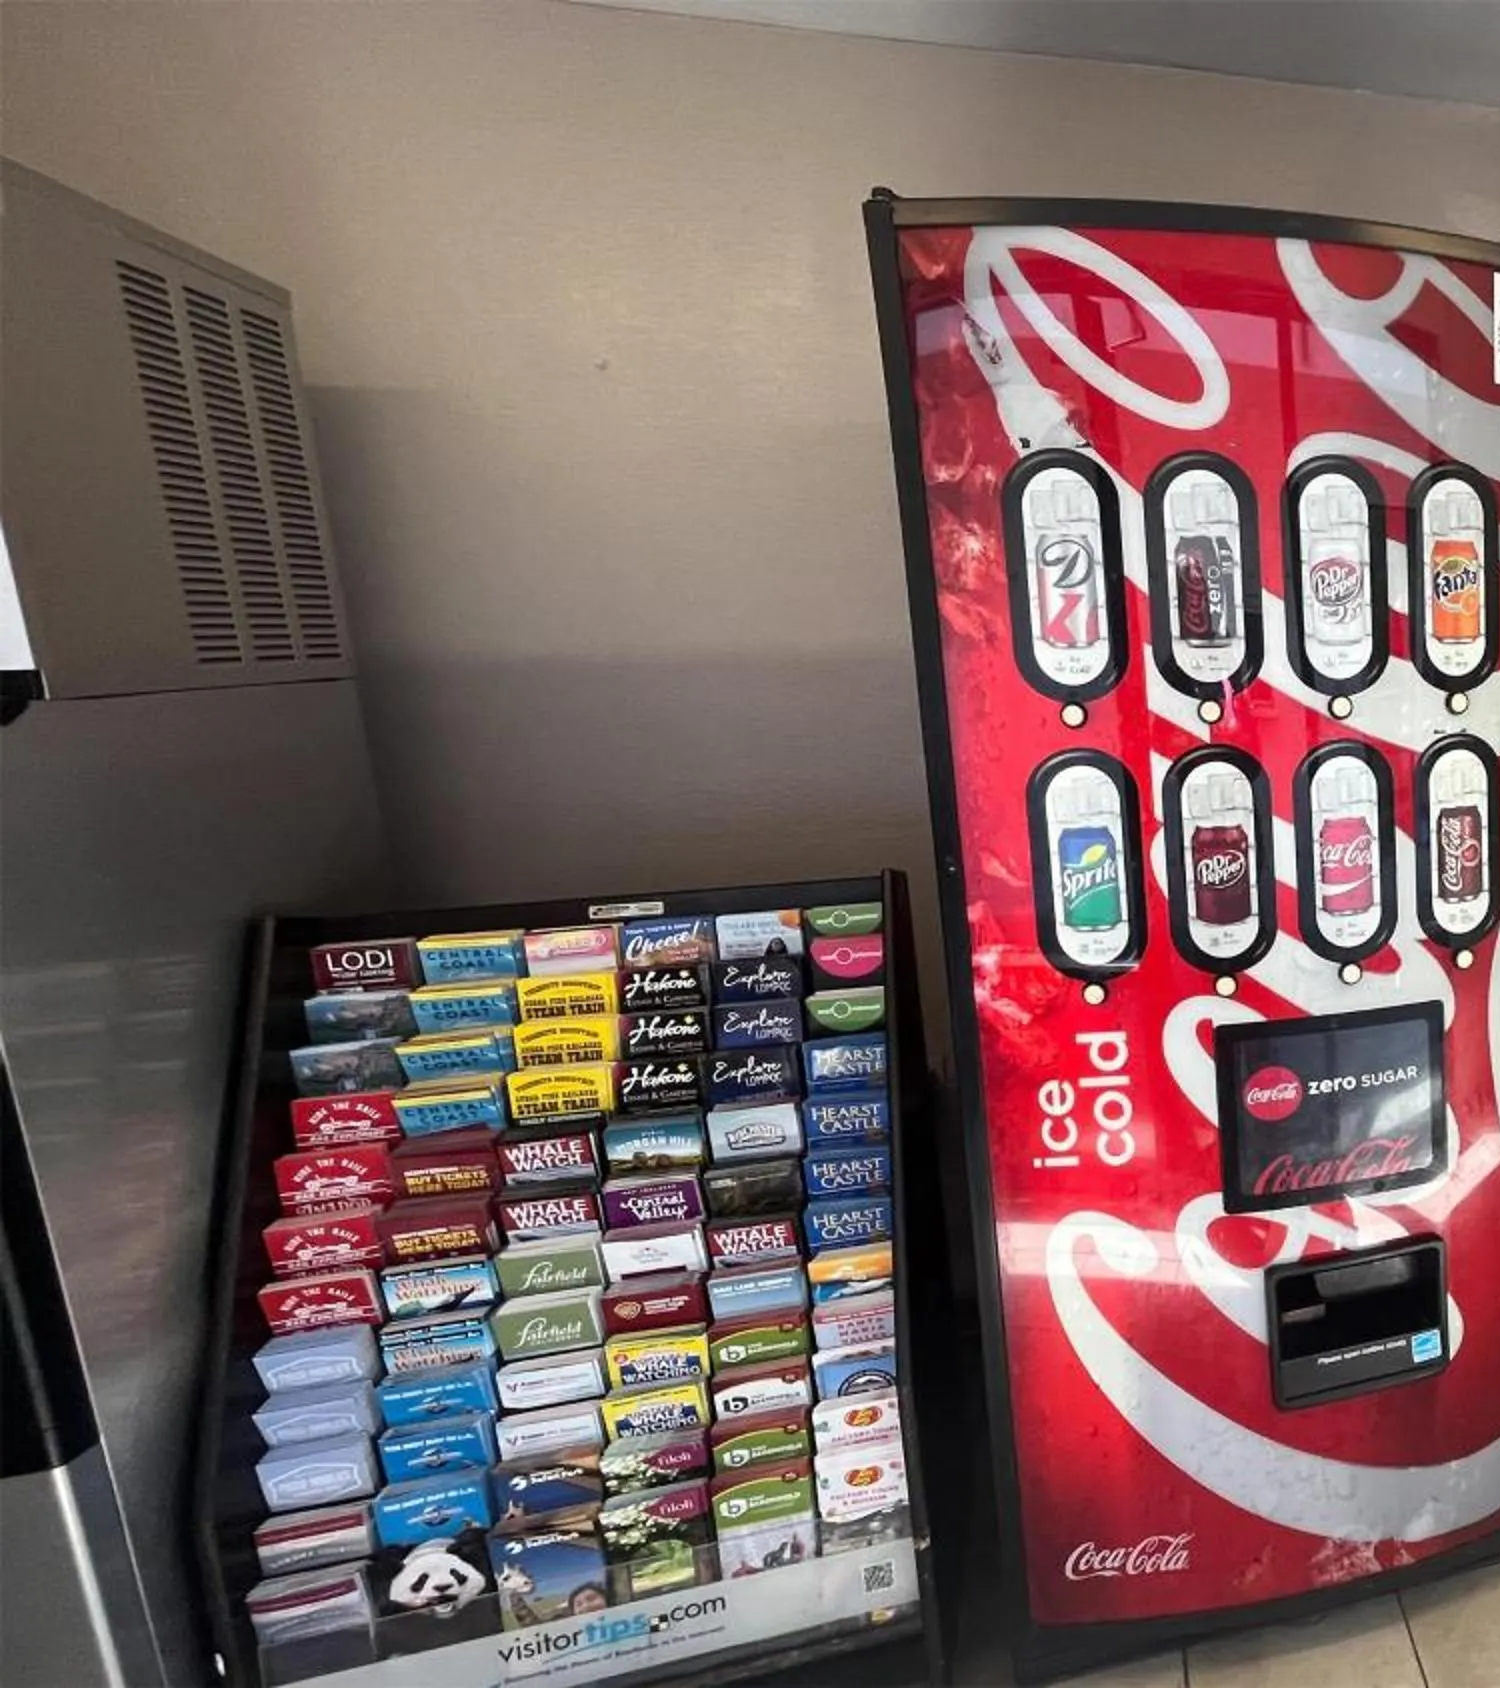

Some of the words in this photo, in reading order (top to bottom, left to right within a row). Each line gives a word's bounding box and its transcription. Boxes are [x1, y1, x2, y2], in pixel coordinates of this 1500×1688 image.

[1208, 566, 1221, 614] zero
[1315, 570, 1358, 600] Pepper
[1214, 853, 1232, 869] Dr
[1198, 857, 1245, 885] Pepper
[626, 920, 700, 961] Cheese!
[325, 948, 395, 973] LODI
[427, 949, 504, 963] CENTRAL
[440, 958, 496, 971] COAST
[624, 969, 697, 999] Hakone
[723, 962, 792, 990] Explore
[419, 998, 501, 1014] CENTRAL
[434, 1008, 492, 1020] COAST
[526, 1006, 566, 1018] STEAM
[570, 1002, 605, 1015] TRAIN
[628, 1015, 701, 1046] Hakone
[723, 1008, 795, 1034] Explore
[408, 1049, 490, 1066] CENTRAL
[424, 1058, 480, 1072] COAST
[522, 1052, 562, 1066] STEAM
[566, 1050, 603, 1062] TRAIN
[816, 1046, 884, 1068] HEARST
[622, 1062, 695, 1094] Hakone
[712, 1056, 782, 1082] Explore
[824, 1062, 885, 1077] CASTLE
[1307, 1076, 1356, 1096] zero
[1360, 1064, 1418, 1088] SUGAR
[332, 1102, 350, 1110] THE
[518, 1102, 559, 1114] STEAM
[562, 1100, 599, 1112] TRAIN
[1076, 1030, 1136, 1167] cold
[404, 1100, 488, 1118] CENTRAL
[812, 1104, 881, 1124] HEARST
[420, 1112, 478, 1126] COAST
[820, 1119, 882, 1134] CASTLE
[1033, 1078, 1079, 1168] ice
[668, 1135, 692, 1147] HILL
[506, 1140, 585, 1163] WHALE
[316, 1158, 335, 1167] THE
[514, 1153, 582, 1172] WATCH
[812, 1158, 885, 1178] HEARST
[820, 1169, 885, 1188] CASTLE
[506, 1200, 589, 1219] WHALE
[620, 1190, 686, 1210] Central
[515, 1210, 586, 1229] WATCH
[632, 1204, 688, 1221] Valley
[812, 1208, 884, 1229] HEARST
[306, 1228, 326, 1237] THE
[714, 1225, 788, 1247] WHALE
[822, 1220, 885, 1239] CASTLE
[720, 1236, 785, 1255] WATCH
[301, 1287, 322, 1297] THE
[632, 1354, 688, 1373] WHALE
[628, 1405, 684, 1427] WHALE
[1065, 1532, 1196, 1581] Coca-Cola
